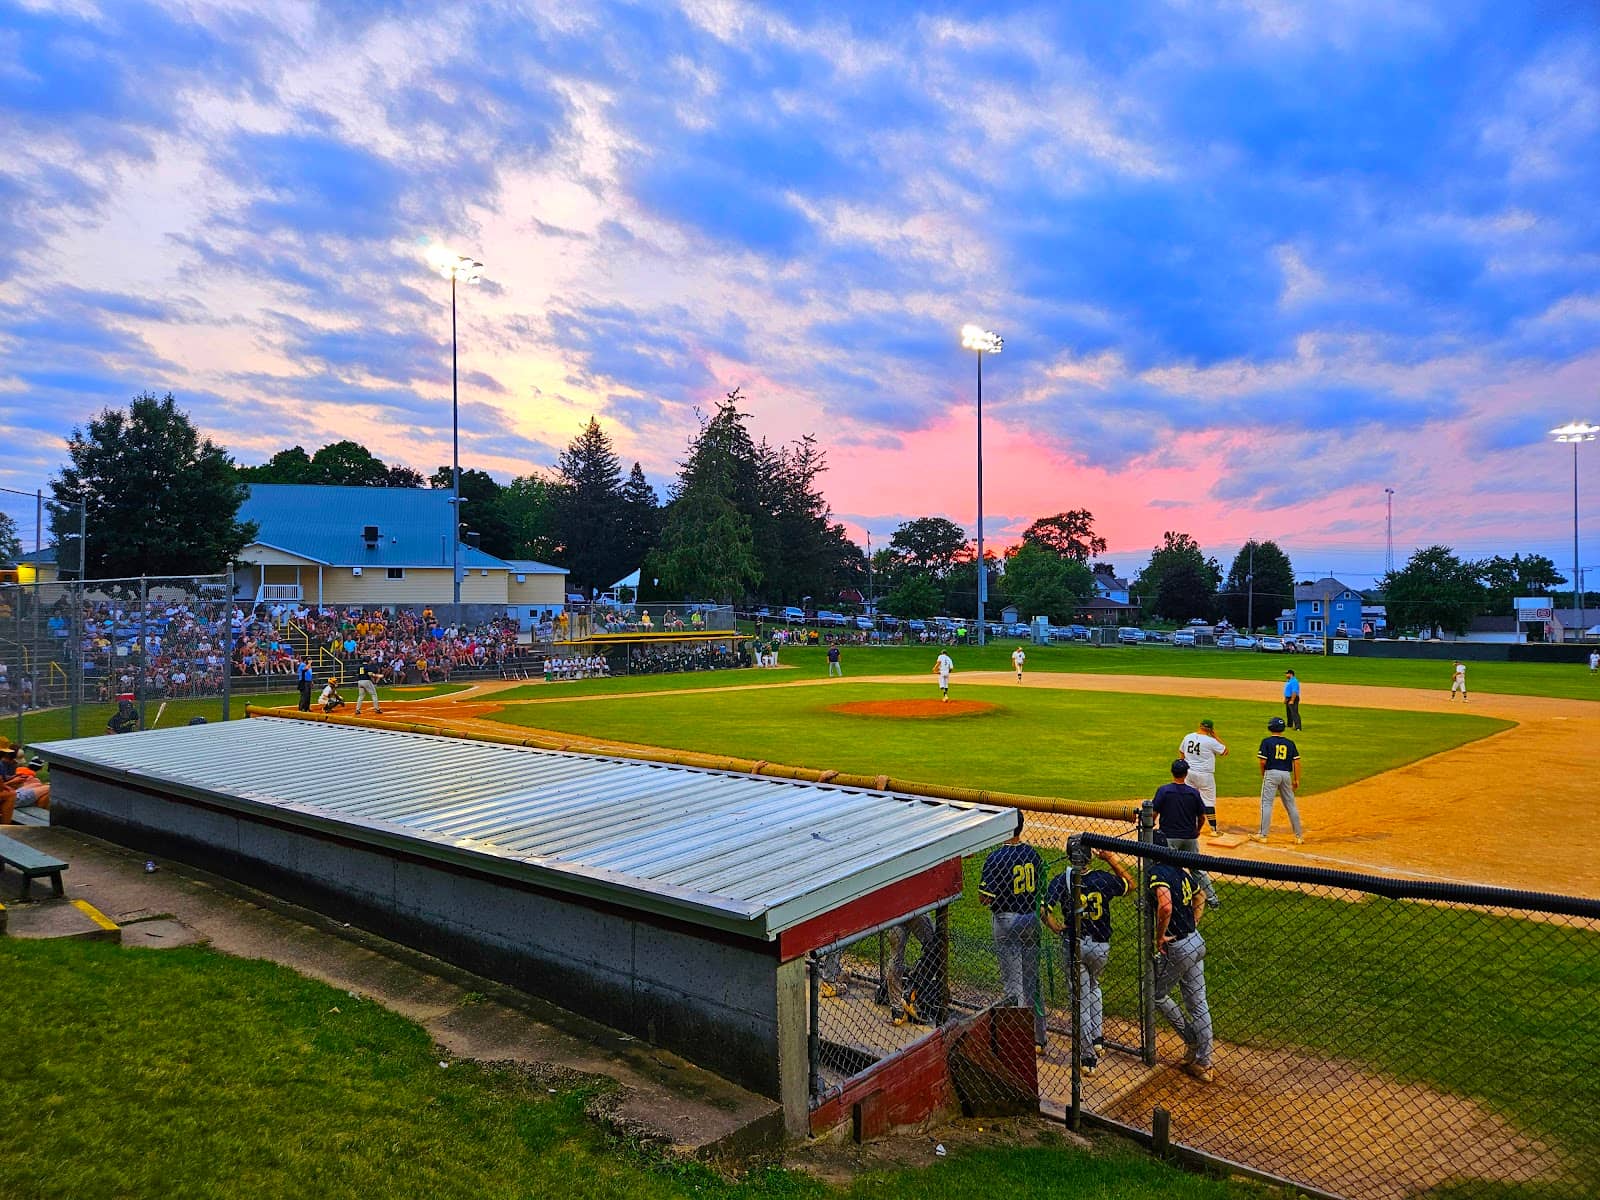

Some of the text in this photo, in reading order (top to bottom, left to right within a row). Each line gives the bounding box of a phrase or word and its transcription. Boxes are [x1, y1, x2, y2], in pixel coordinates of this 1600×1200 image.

[1187, 740, 1201, 756] 24
[1275, 744, 1288, 760] 19
[1012, 863, 1036, 895] 20
